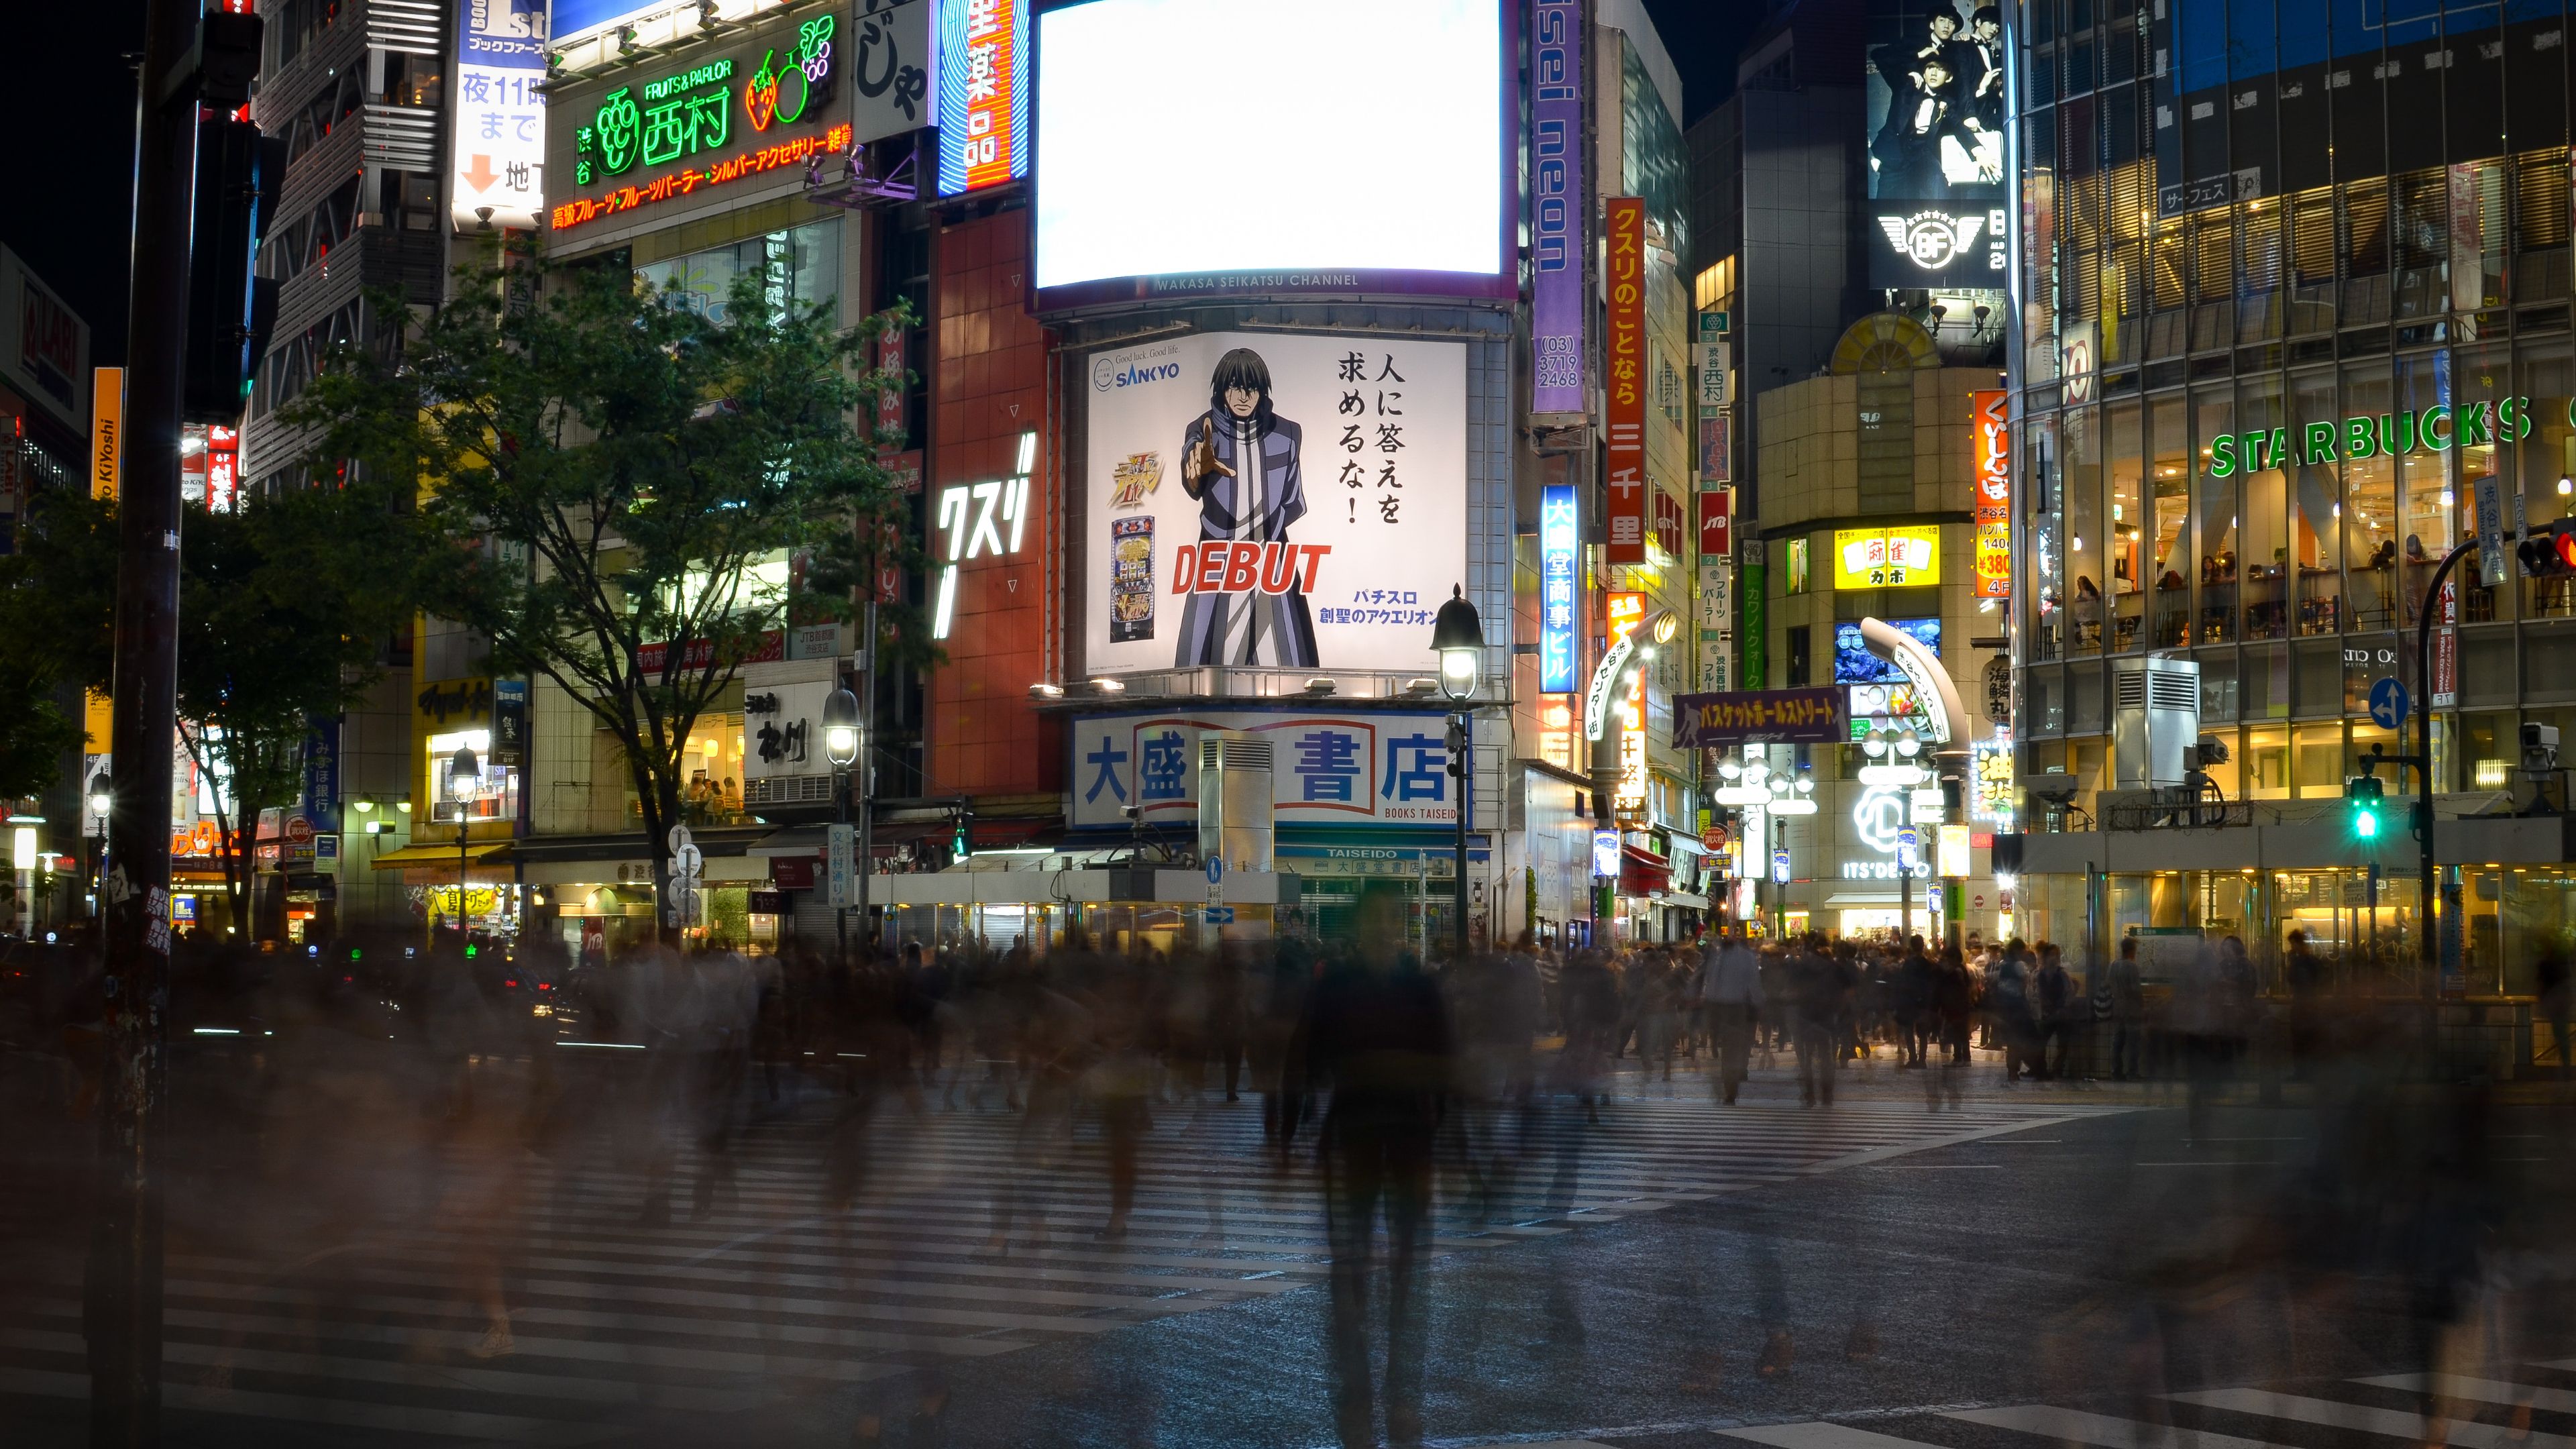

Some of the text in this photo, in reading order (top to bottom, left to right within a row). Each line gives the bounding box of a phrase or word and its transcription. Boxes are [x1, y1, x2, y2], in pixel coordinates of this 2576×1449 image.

[857, 0, 927, 121] じゃ
[481, 113, 535, 142] まで
[643, 86, 731, 166] 西村
[576, 127, 592, 185] 渋谷
[1538, 119, 1567, 272] neon
[2165, 184, 2226, 208] サーフェス
[1916, 232, 1948, 258] BF
[1157, 274, 1358, 290] WAKASA SEIKATSU CHANNEL
[1115, 352, 1132, 364] Good
[1150, 348, 1167, 358] Good
[1542, 335, 1574, 354] (03)
[1116, 362, 1180, 388] SANKYO
[1538, 355, 1578, 372] 3719
[1539, 372, 1578, 388] 2468
[1610, 209, 1642, 545] クスリのことなら 三千里
[1338, 351, 1368, 524] 求めるな！
[1375, 353, 1406, 524] 人に答えを
[2210, 396, 2533, 478] STARBUCKS
[215, 453, 229, 462] 6F
[1703, 516, 1726, 531] JTB
[1868, 541, 1904, 561] 麻雀
[1171, 539, 1332, 595] DEBUT
[1870, 570, 1904, 585] カボ
[1353, 588, 1417, 605] パチスロ
[1703, 588, 1715, 625] パーラー
[1716, 581, 1725, 619] フルーツ
[1085, 730, 1447, 804] 大盛書店
[1980, 746, 2012, 781] 油
[1385, 808, 1456, 819] BOOKS TAISEID
[291, 825, 309, 836] 消火栓
[1705, 834, 1725, 844] 消火栓
[832, 830, 843, 895] 文化村通り
[1327, 849, 1397, 859] TAISEIDO
[1337, 860, 1420, 873] 大盛堂書店
[1843, 861, 1931, 879] ITS'DEO
